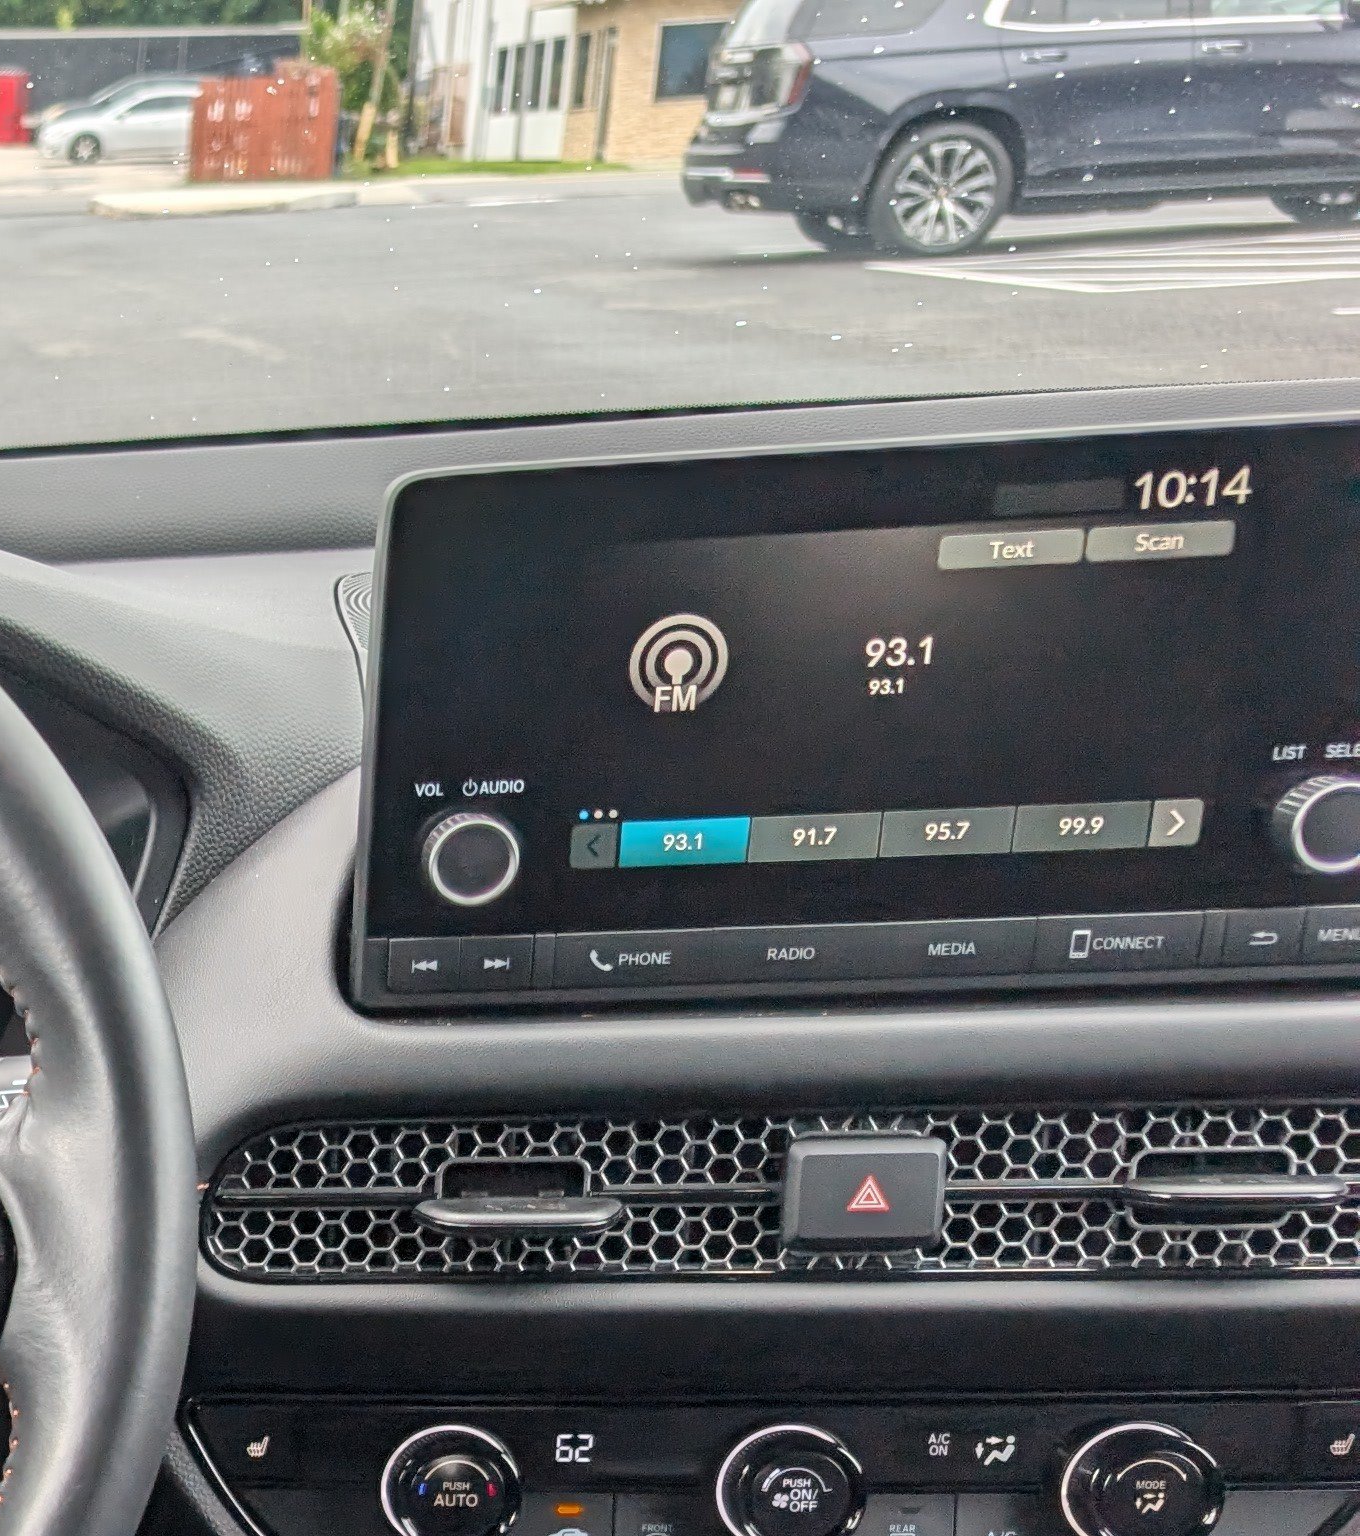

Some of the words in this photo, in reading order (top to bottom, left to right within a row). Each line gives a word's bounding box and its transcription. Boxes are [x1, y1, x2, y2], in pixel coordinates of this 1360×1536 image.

[1134, 464, 1253, 510] 10:14
[990, 539, 1034, 560] Text
[1133, 532, 1186, 553] Scan
[865, 636, 935, 668] 93.1
[868, 678, 905, 696] 93.1
[653, 684, 698, 713] FM
[1273, 743, 1307, 761] LIST
[414, 781, 445, 799] VOL
[479, 778, 526, 796] AUDIO
[923, 821, 972, 842] 95.7
[1057, 816, 1106, 837] 99.9
[661, 832, 706, 854] 93.1
[791, 826, 838, 848] 91.7
[927, 940, 977, 958] MEDIA
[1092, 934, 1165, 952] CONNECT
[618, 950, 672, 967] PHONE
[765, 946, 816, 962] RADIO
[927, 1431, 951, 1445] A/C
[554, 1433, 595, 1464] 62
[928, 1444, 949, 1457] ON
[441, 1480, 470, 1492] PUSH
[782, 1477, 812, 1489] PUSH
[1135, 1479, 1167, 1491] MODE
[433, 1493, 479, 1508] AUTO
[788, 1487, 820, 1501] ON/
[788, 1500, 819, 1513] OFF
[641, 1523, 673, 1533] FRONT
[888, 1523, 917, 1533] REAR
